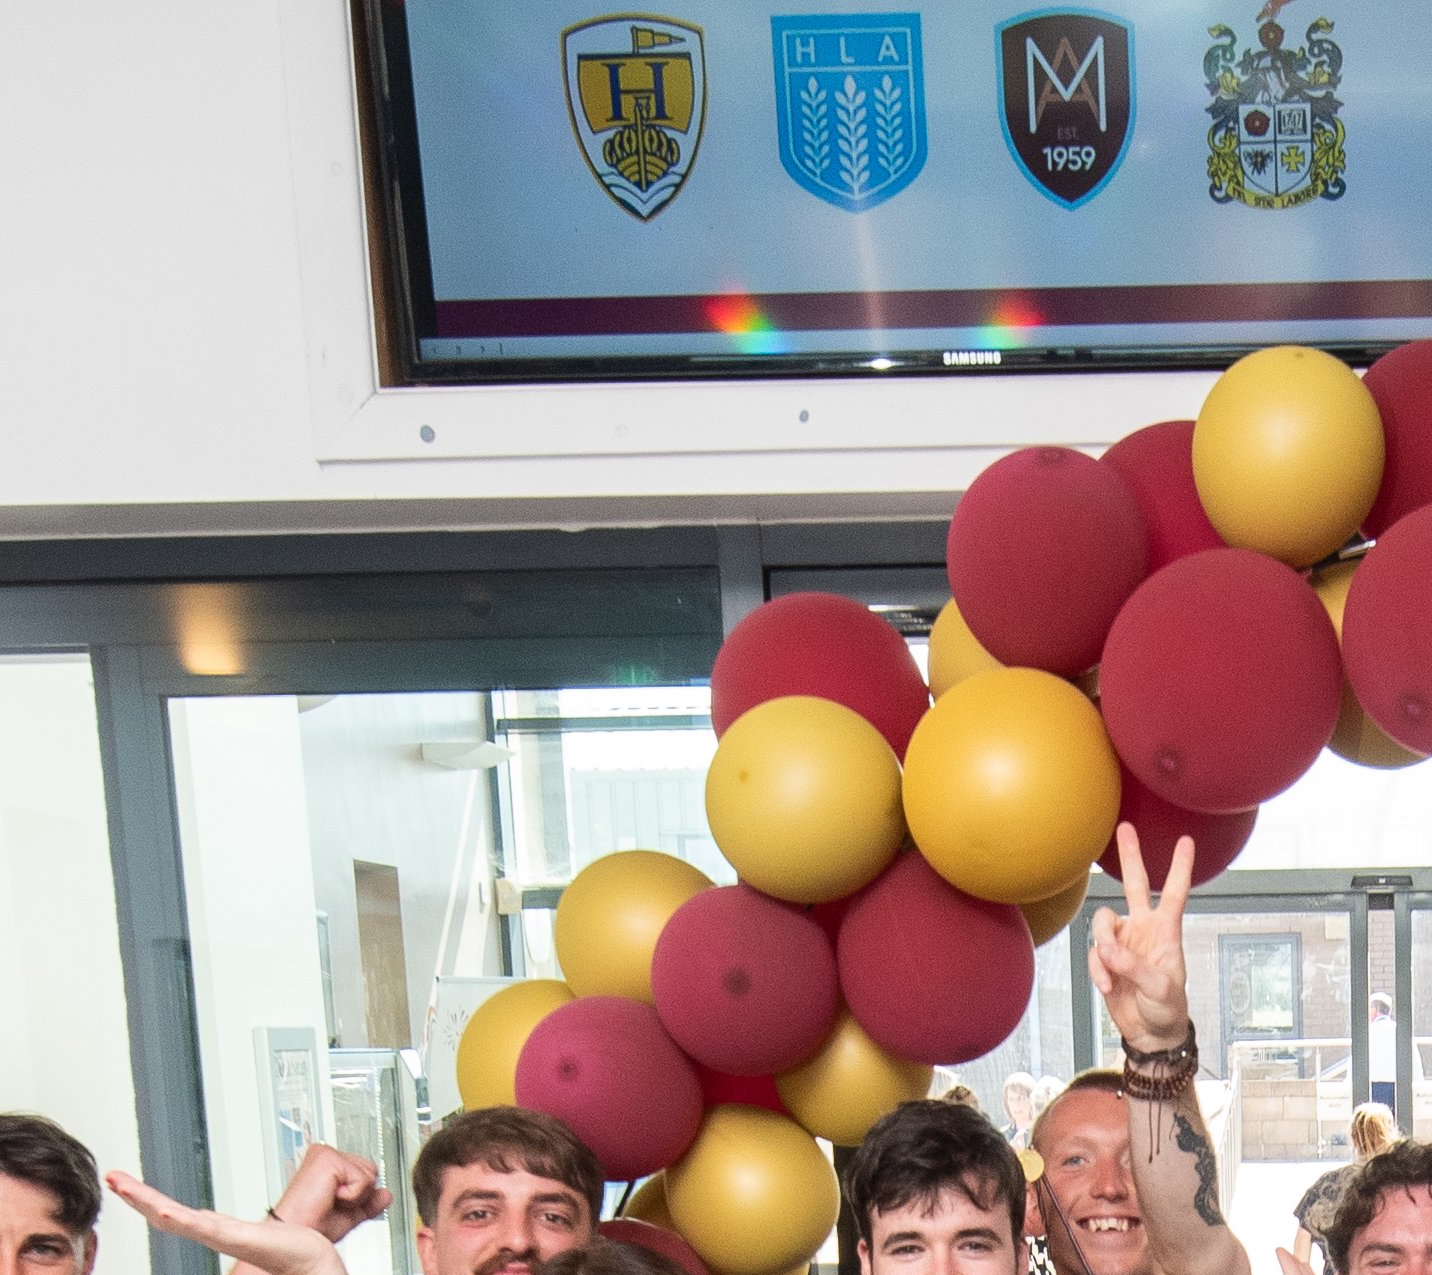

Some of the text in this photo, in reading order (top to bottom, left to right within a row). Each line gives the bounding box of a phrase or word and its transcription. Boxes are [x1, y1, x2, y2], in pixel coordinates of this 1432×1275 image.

[609, 61, 668, 123] H
[1043, 146, 1096, 172] 1959
[943, 352, 1001, 365] SAMSUNG
